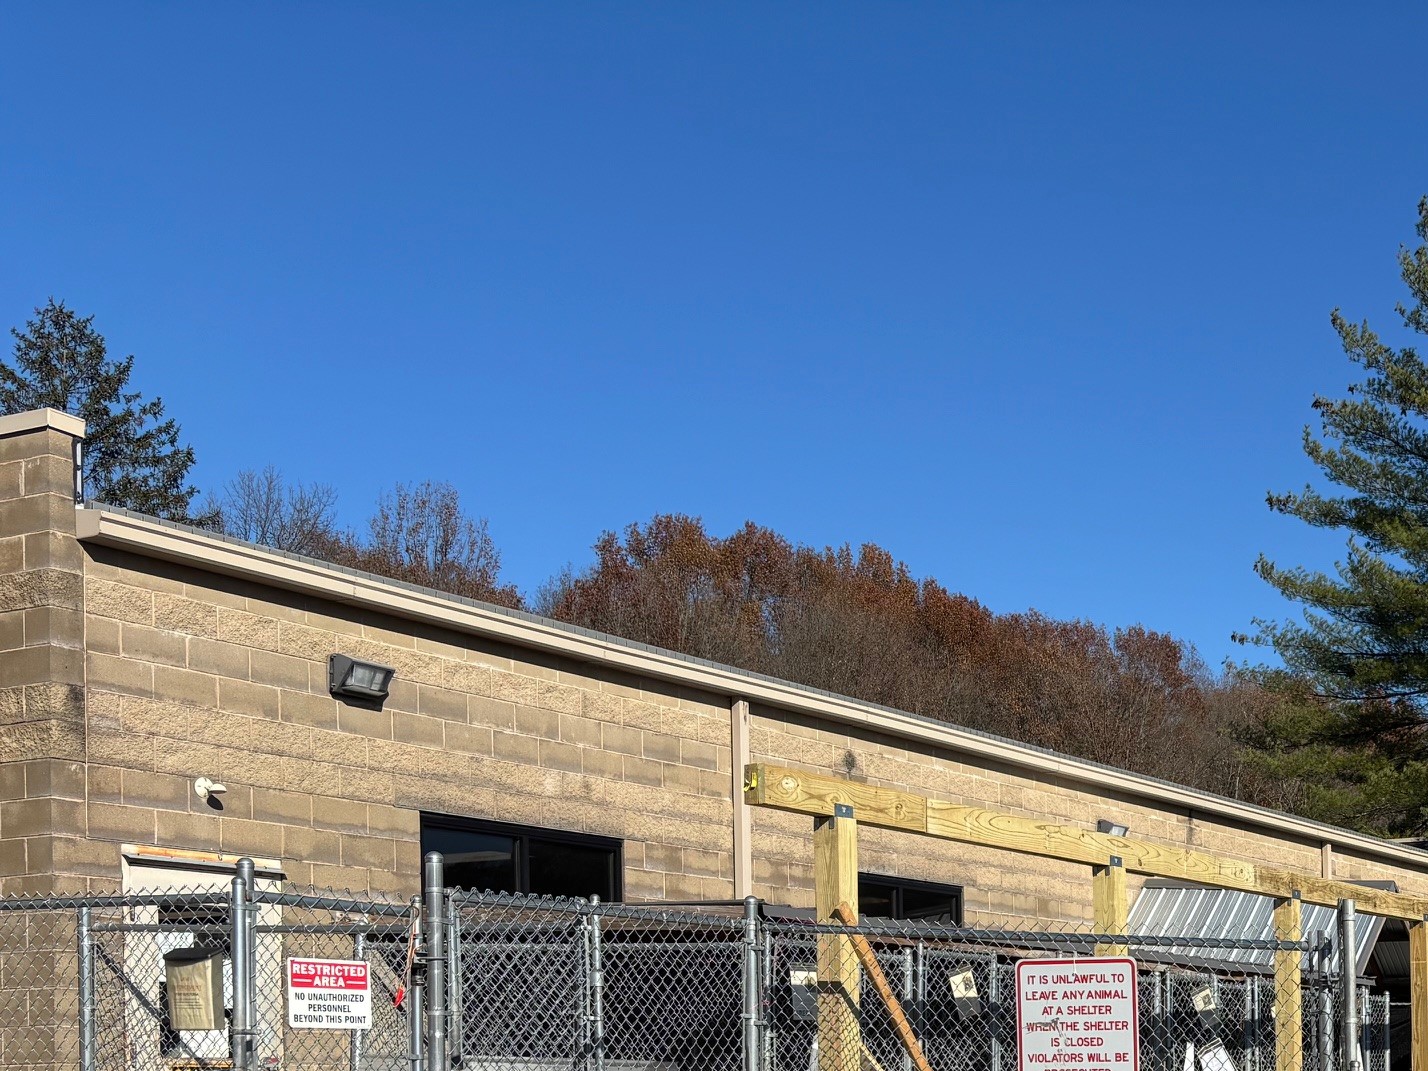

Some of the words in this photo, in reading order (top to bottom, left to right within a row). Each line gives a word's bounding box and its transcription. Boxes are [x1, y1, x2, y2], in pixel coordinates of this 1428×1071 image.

[292, 963, 366, 977] RESTRICTED
[313, 976, 346, 987] AREA
[1027, 974, 1036, 985] IT
[1039, 974, 1049, 985] IS
[1051, 973, 1110, 985] UNLAWFUL
[1111, 973, 1125, 984] TO
[294, 992, 306, 1001] NO
[307, 992, 365, 1003] UNAUTHORIZED
[1025, 990, 1058, 1001] LEAVE
[1061, 990, 1085, 1000] ANY
[1086, 989, 1128, 1000] ANIMAL
[308, 1003, 352, 1013] PERSONNEL
[1042, 1006, 1054, 1016] AT
[1056, 1006, 1064, 1016] A
[1066, 1005, 1112, 1015] SHELTER
[293, 1013, 324, 1023] BEYOND
[325, 1014, 343, 1024] THIS
[344, 1015, 367, 1024] POINT
[1026, 1021, 1057, 1032] WHEN
[1060, 1021, 1080, 1032] THE
[1083, 1020, 1129, 1031] SHELTER
[1050, 1037, 1060, 1048] IS
[1064, 1037, 1104, 1047] CLOSED
[1027, 1052, 1084, 1063] VIOLATORS
[1087, 1052, 1112, 1063] WILL
[1114, 1052, 1130, 1063] BE
